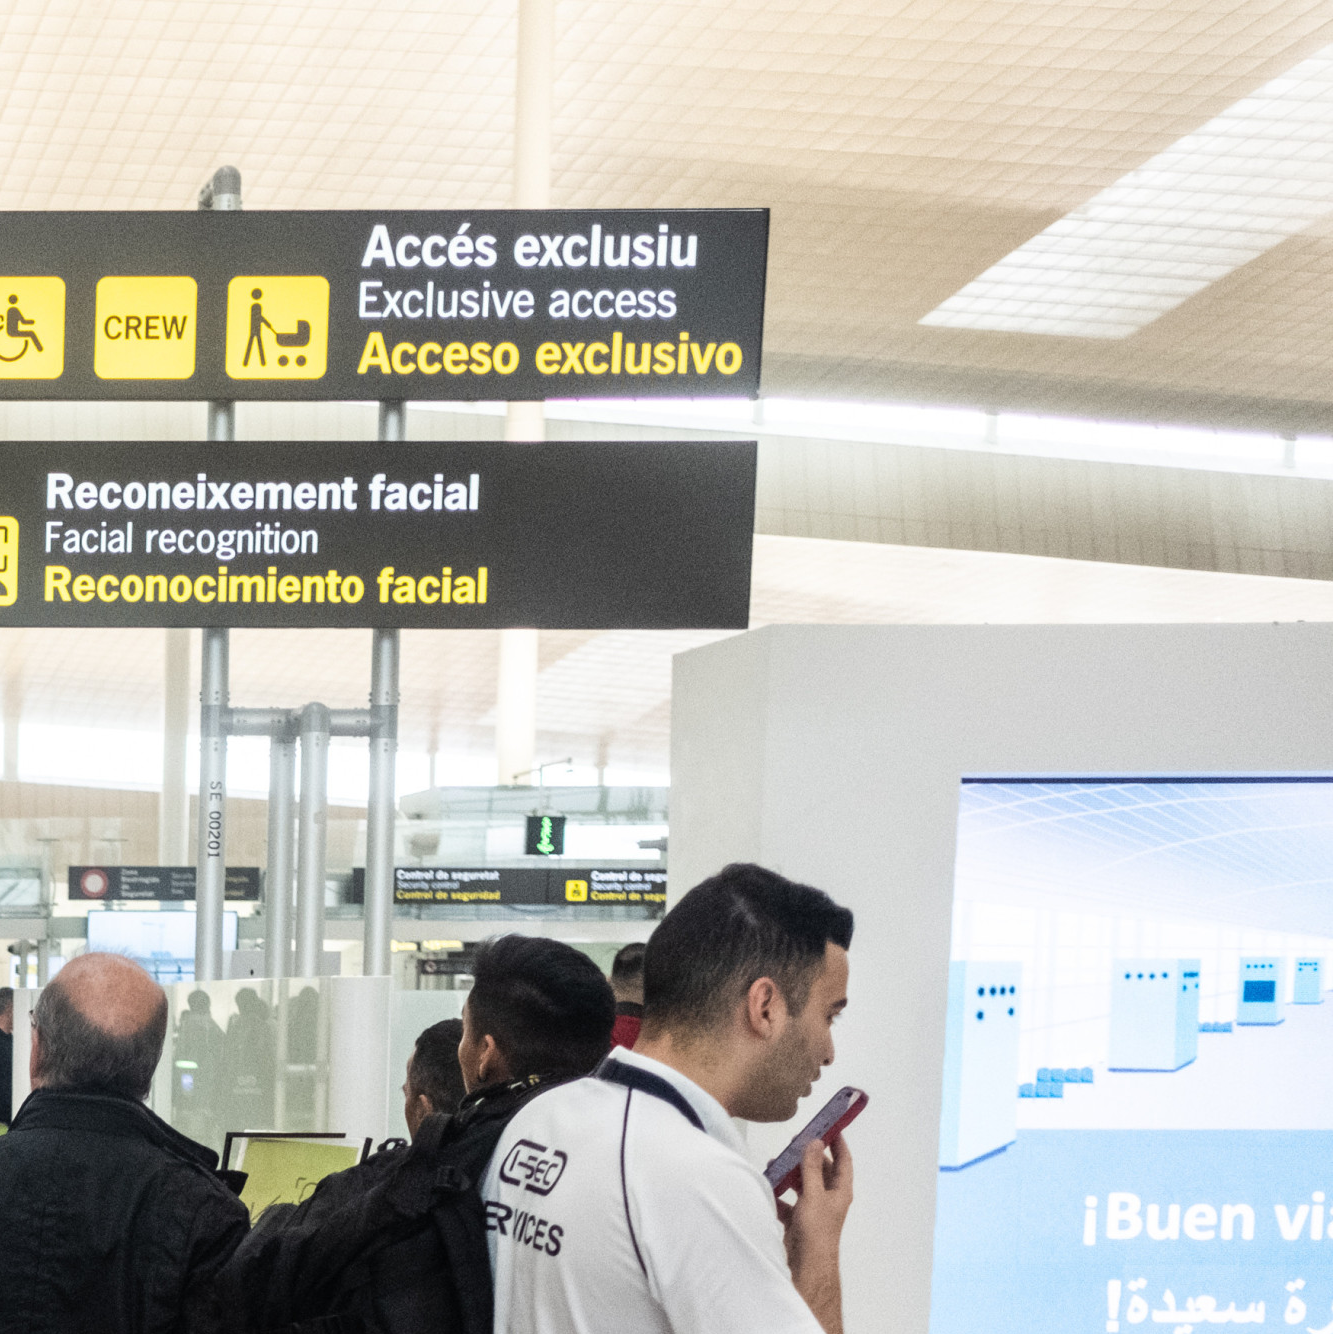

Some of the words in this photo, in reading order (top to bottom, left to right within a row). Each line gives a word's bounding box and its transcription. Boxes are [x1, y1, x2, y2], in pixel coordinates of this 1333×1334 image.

[361, 223, 497, 269] Accés
[514, 224, 697, 269] exclusiu
[359, 280, 535, 319] Exclusive
[548, 288, 677, 320] access
[104, 315, 187, 340] CREW
[357, 331, 519, 375] Acceso
[535, 331, 743, 375] exclusivo
[47, 473, 358, 511] Reconeixement
[369, 474, 479, 511] facial
[45, 521, 133, 554] Facial
[146, 522, 318, 561] recognition
[44, 565, 364, 603] Reconocimiento
[377, 567, 487, 604] facial
[210, 781, 222, 801] SE
[396, 869, 434, 880] Control
[435, 869, 449, 880] de
[451, 870, 500, 882] seguretat
[591, 871, 628, 881] Control
[629, 871, 643, 881] de
[396, 890, 433, 899] Control
[436, 890, 448, 899] de
[450, 890, 501, 901] seguridad
[591, 891, 627, 900] Control
[628, 891, 641, 900] de
[485, 1200, 565, 1257] ERVICES
[1083, 1191, 1256, 1246] ¡Buen
